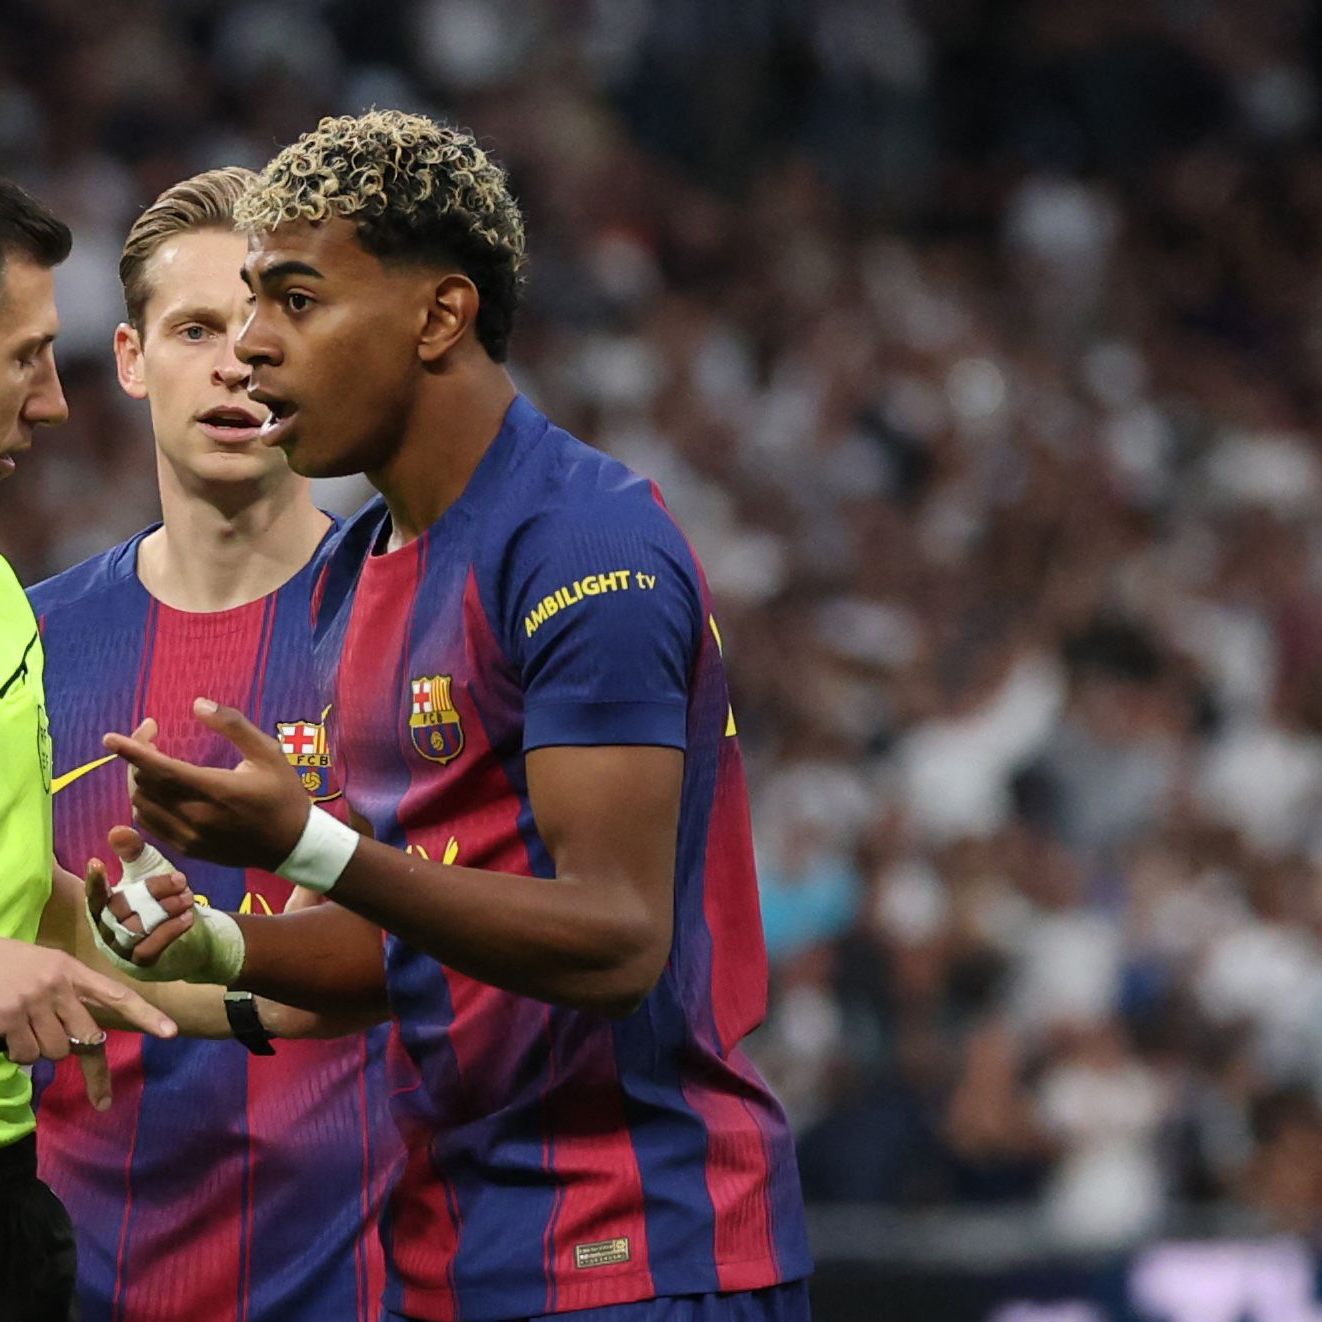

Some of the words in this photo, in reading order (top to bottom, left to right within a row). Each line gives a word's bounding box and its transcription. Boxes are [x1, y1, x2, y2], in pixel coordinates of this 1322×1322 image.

[524, 570, 630, 638] AMBILIGHT
[635, 571, 656, 590] tv
[296, 754, 329, 766] FCB
